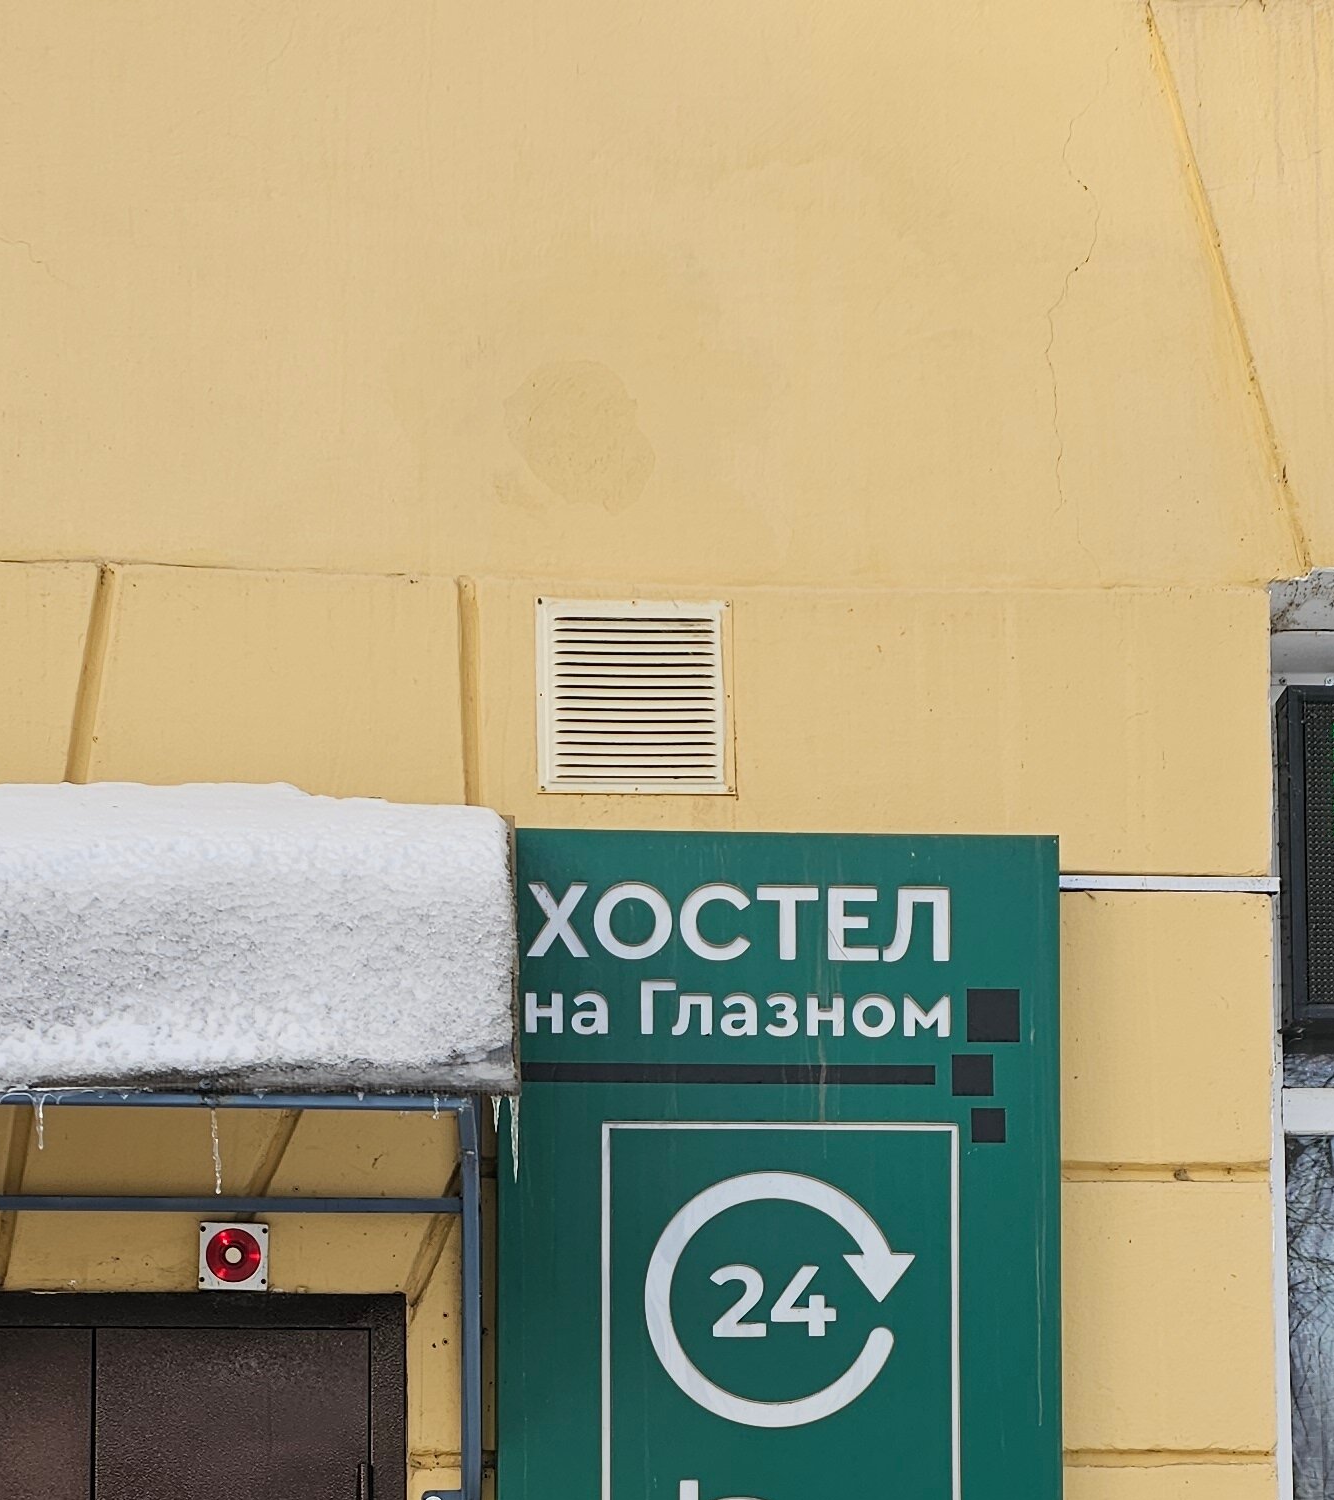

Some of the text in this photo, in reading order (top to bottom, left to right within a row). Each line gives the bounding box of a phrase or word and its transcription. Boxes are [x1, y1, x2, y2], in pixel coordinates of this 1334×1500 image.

[526, 881, 951, 962] ХОСТЕЛ
[525, 979, 951, 1037] на Глазном
[709, 1263, 837, 1337] 24
